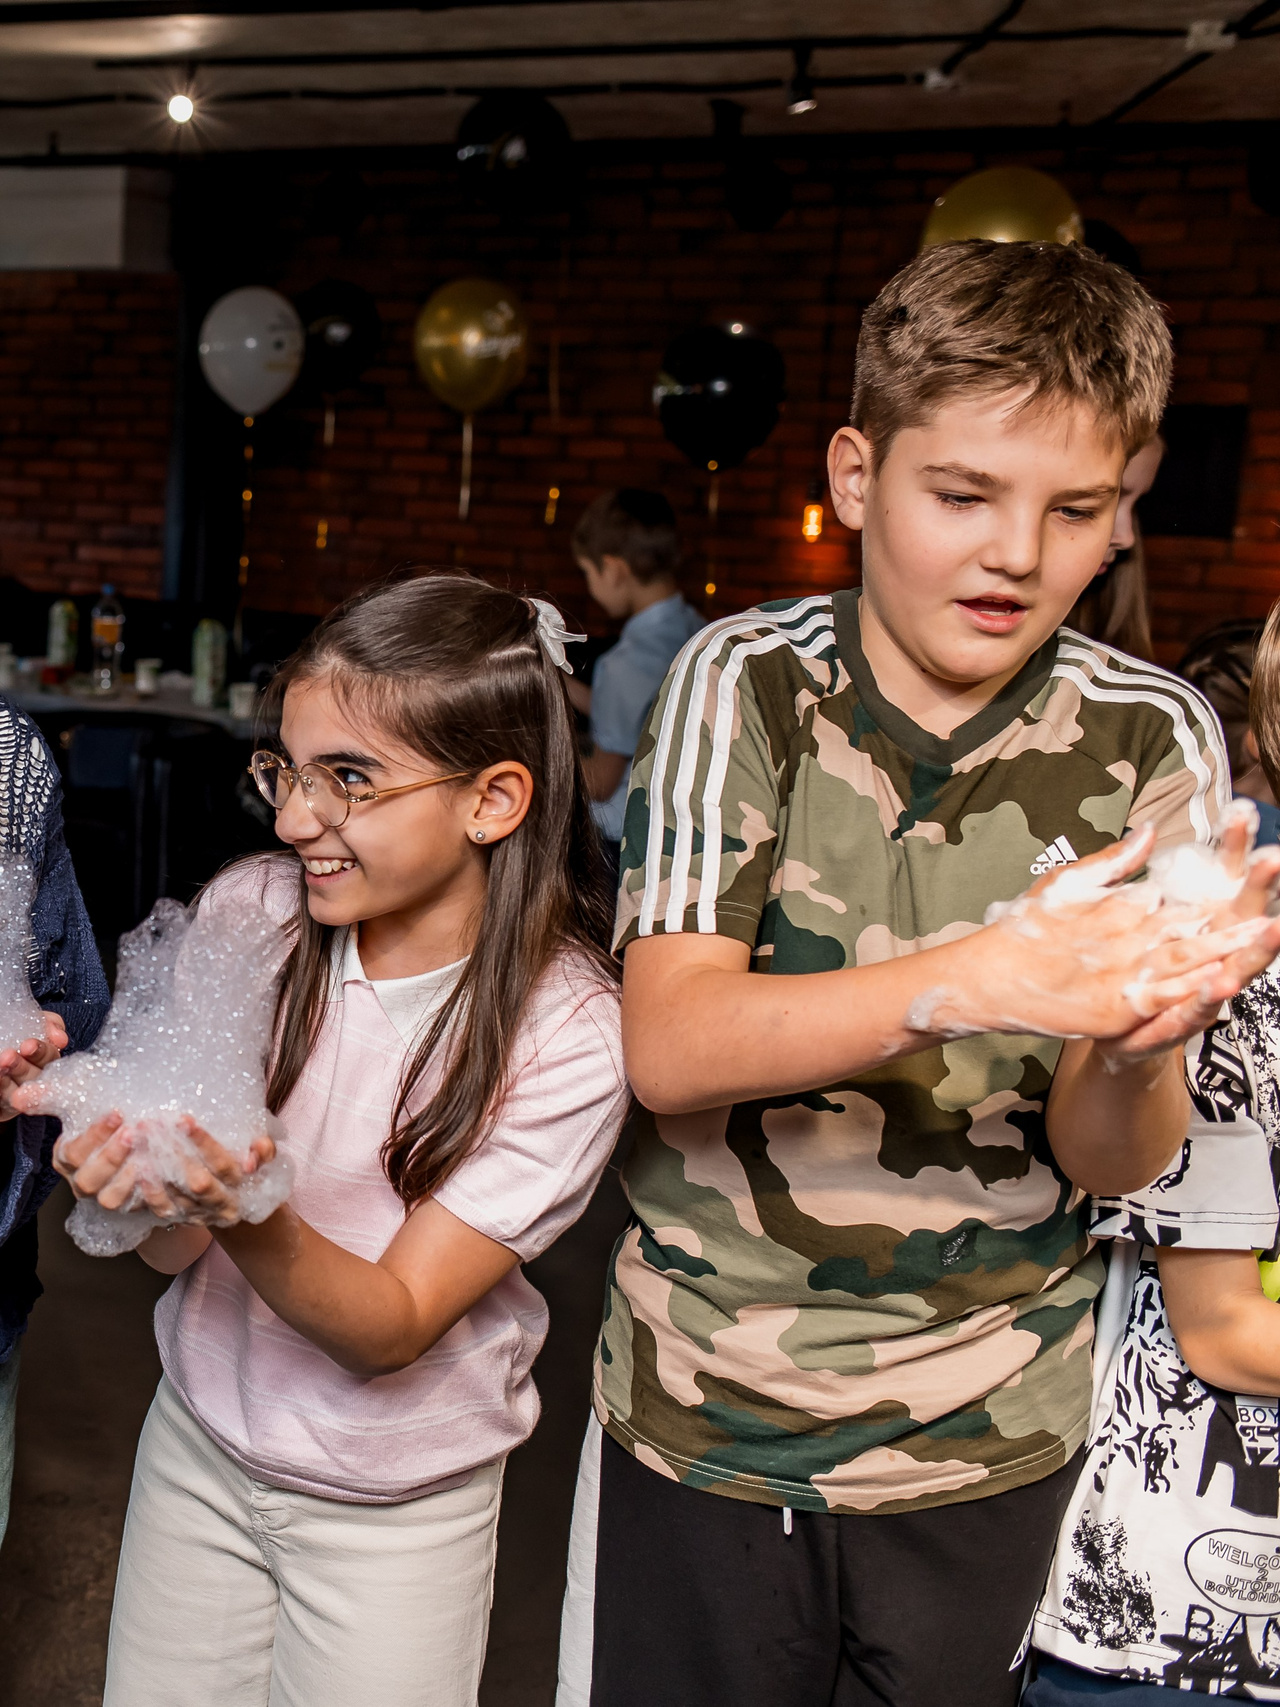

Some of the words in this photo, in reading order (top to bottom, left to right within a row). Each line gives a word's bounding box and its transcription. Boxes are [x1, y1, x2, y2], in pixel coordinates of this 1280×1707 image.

[1238, 1408, 1279, 1424] BOY
[1256, 1568, 1269, 1581] 2
[1204, 1580, 1280, 1604] BOYLOND
[1225, 1575, 1280, 1594] UTOPI
